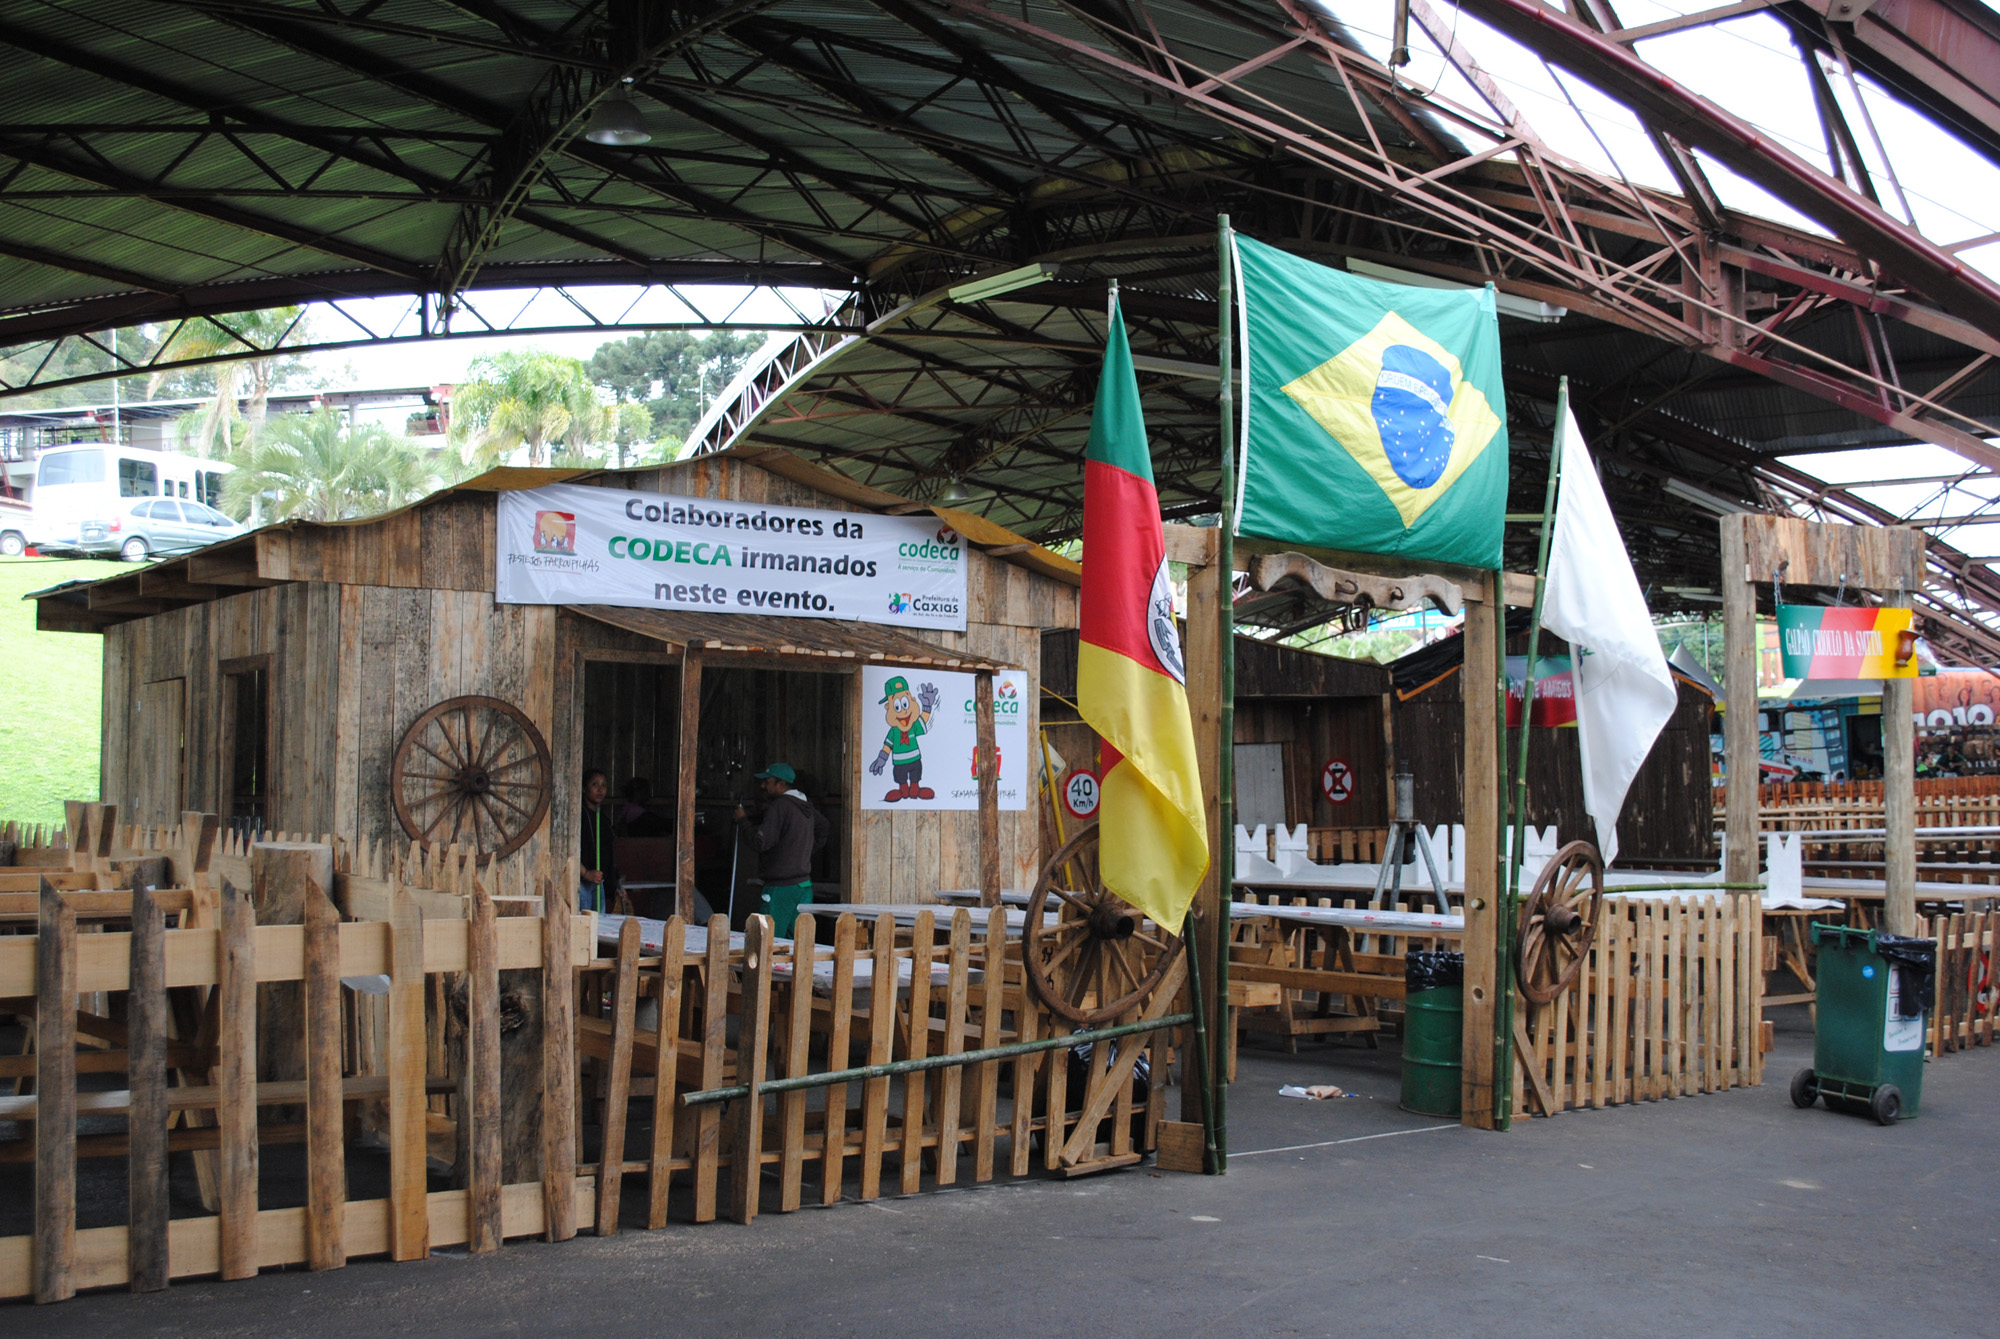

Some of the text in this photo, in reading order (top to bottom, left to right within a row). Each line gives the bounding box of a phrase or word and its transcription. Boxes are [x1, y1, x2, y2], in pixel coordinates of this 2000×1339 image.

[1381, 372, 1412, 390] ORDEM
[624, 498, 864, 539] Colaboradores da
[608, 535, 878, 577] CODECA irmanados
[898, 538, 960, 561] codeca
[507, 553, 601, 573] FESTEJOS FARROUPILHAS
[653, 582, 836, 612] neste evento.
[912, 598, 959, 614] Caxias
[921, 594, 950, 603] Prefeitura
[1843, 630, 1856, 657] DA
[964, 699, 1019, 714] ceca
[1070, 778, 1093, 797] 40
[1072, 797, 1094, 809] Km/h
